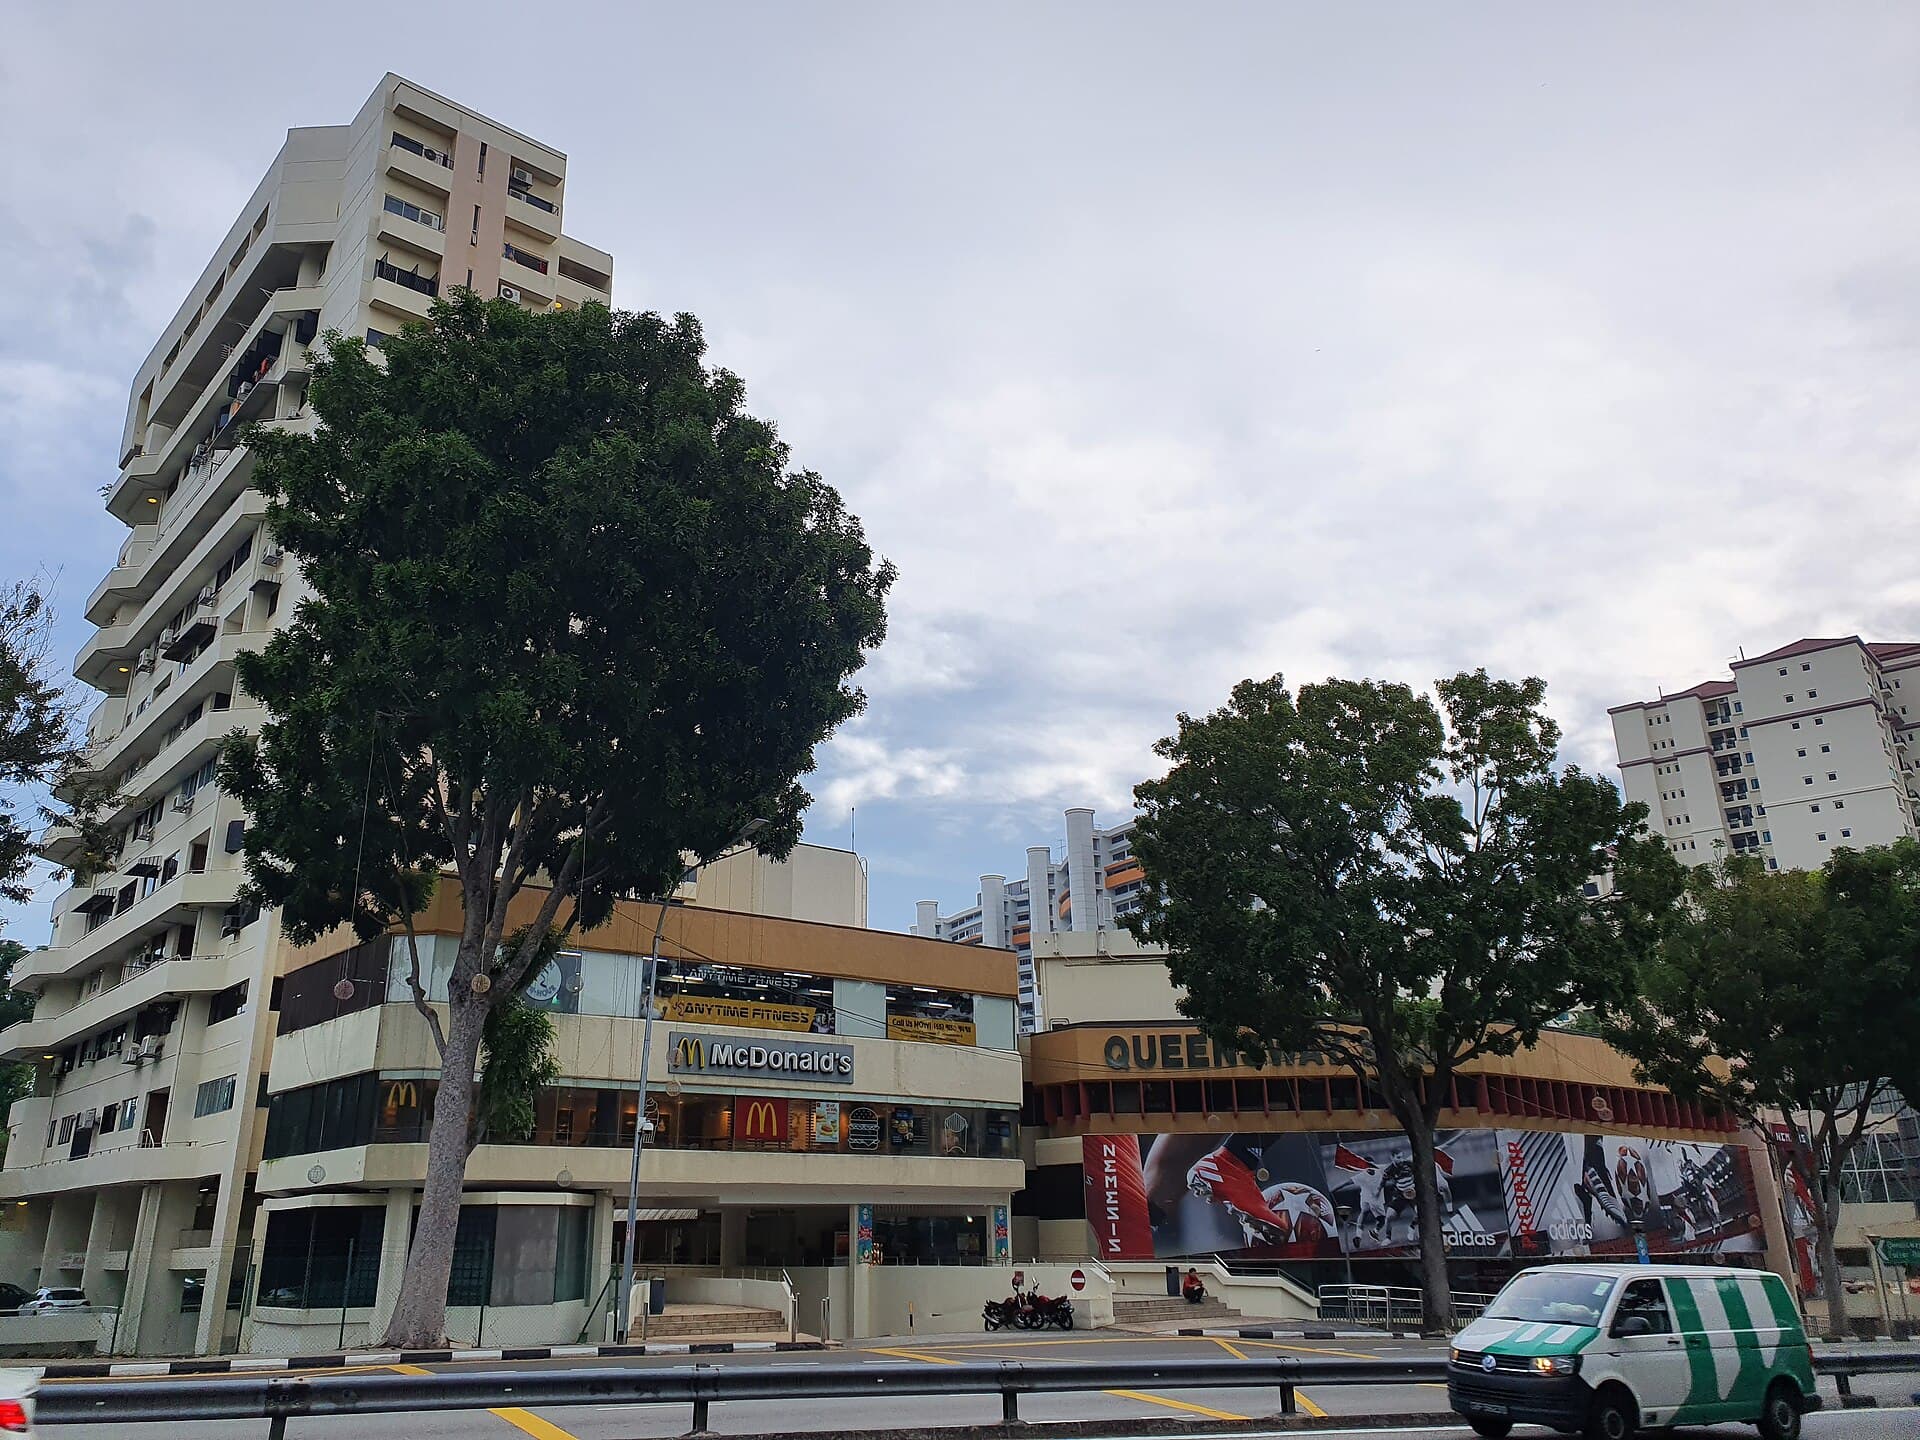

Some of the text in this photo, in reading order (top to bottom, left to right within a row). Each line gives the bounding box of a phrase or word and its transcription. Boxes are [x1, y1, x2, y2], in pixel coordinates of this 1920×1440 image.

[689, 968, 799, 988] ANYTIME FITNESS
[684, 1002, 809, 1024] ANYTIME FITNESS
[892, 1018, 904, 1027] Call
[710, 1043, 853, 1074] McDonald's
[1507, 1141, 1539, 1250] PREDATOR
[1550, 1218, 1593, 1240] adidas
